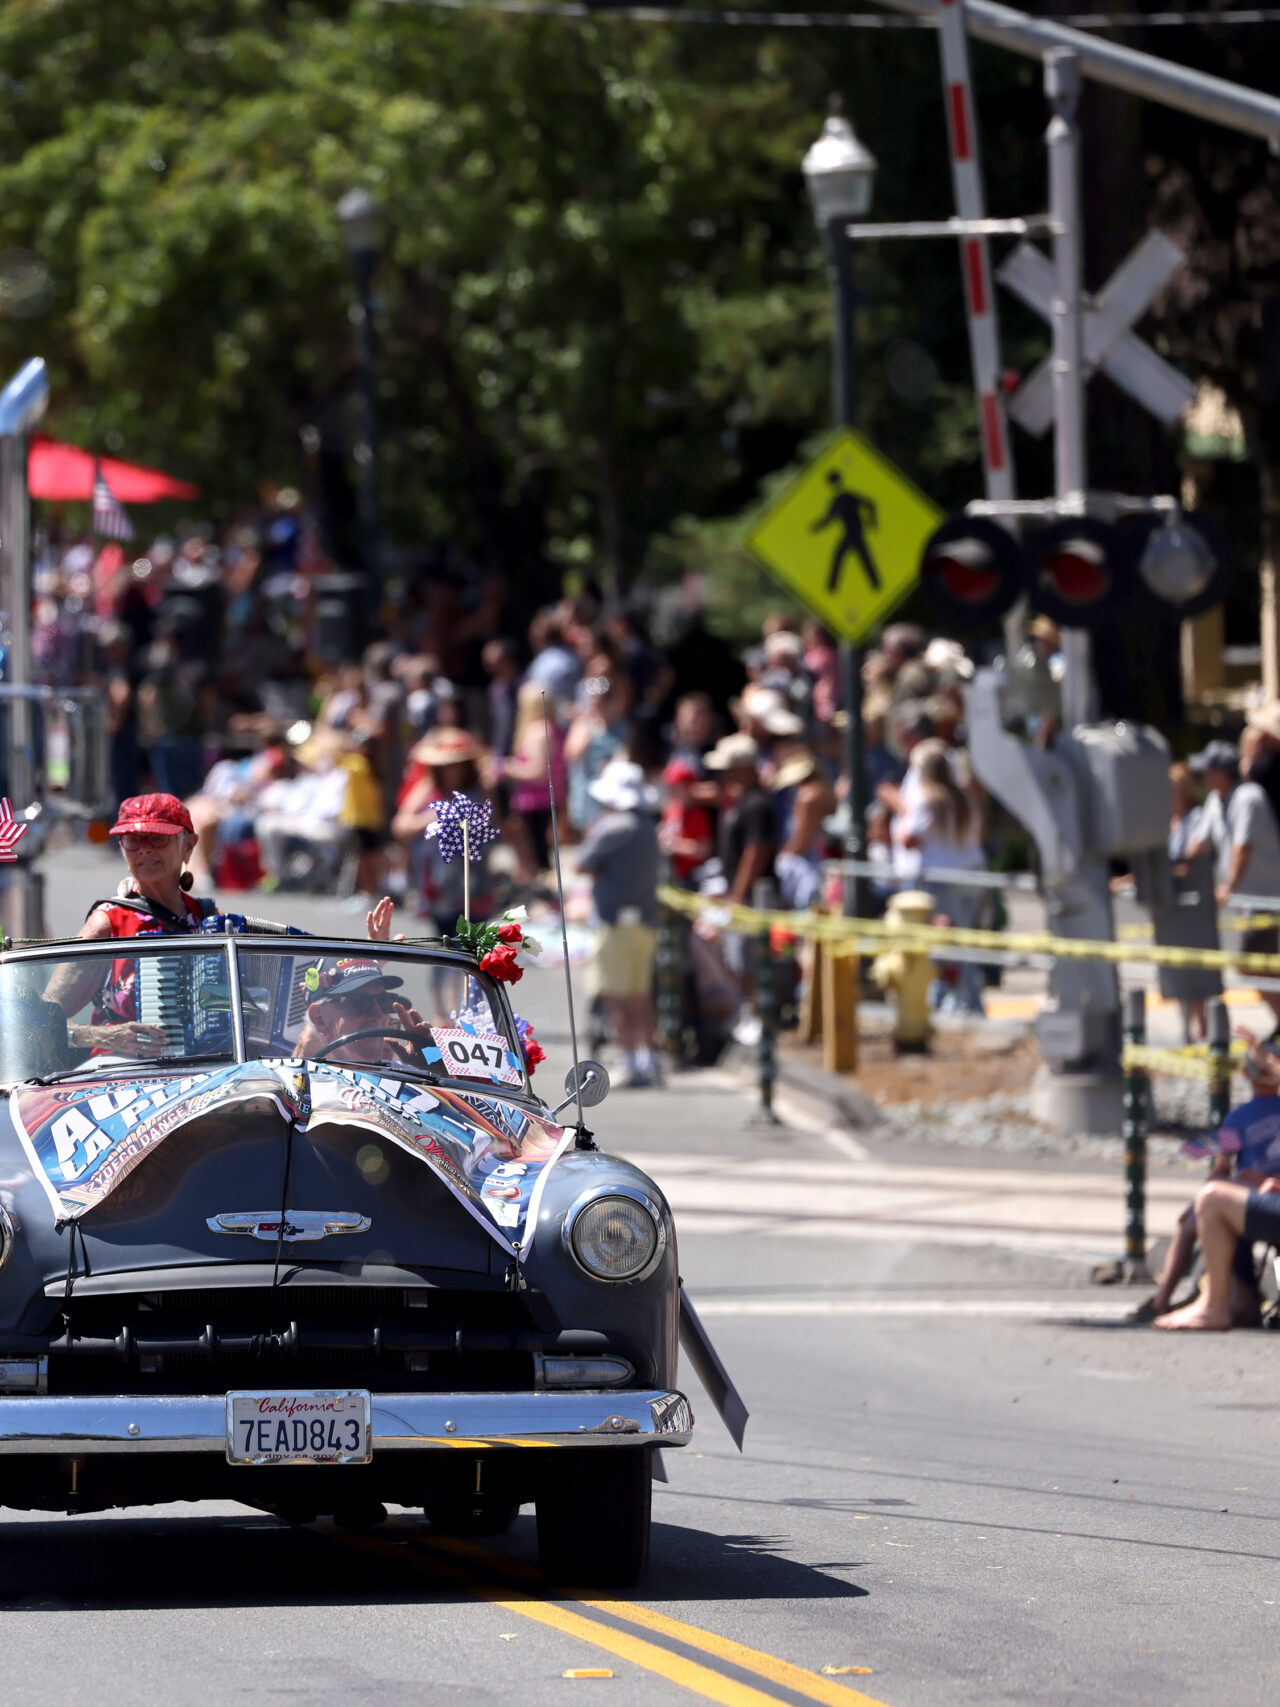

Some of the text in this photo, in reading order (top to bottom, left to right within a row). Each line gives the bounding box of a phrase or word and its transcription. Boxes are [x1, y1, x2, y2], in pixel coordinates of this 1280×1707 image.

[447, 1040, 503, 1069] 047
[87, 1104, 188, 1192] ZYDECO DANCE
[258, 1397, 344, 1417] California
[239, 1418, 361, 1453] 7EAD843
